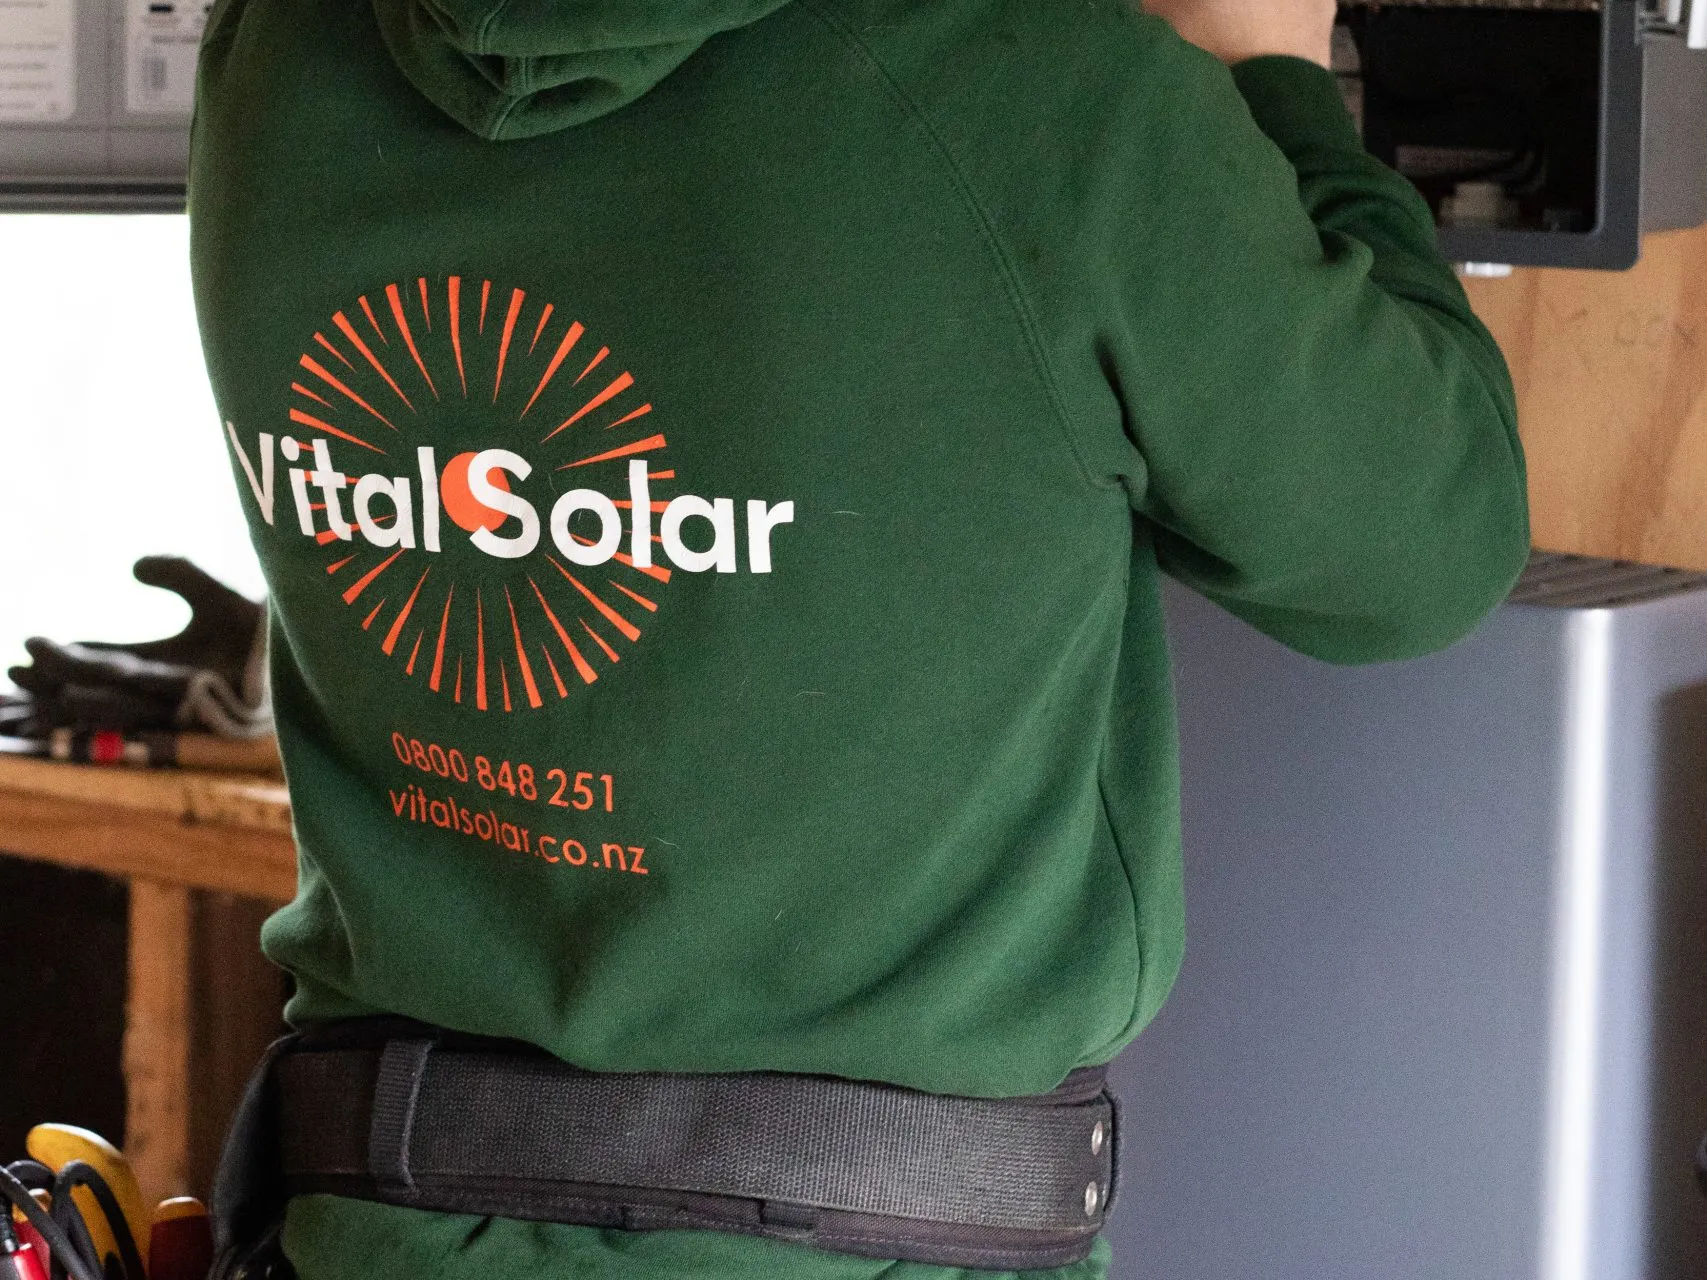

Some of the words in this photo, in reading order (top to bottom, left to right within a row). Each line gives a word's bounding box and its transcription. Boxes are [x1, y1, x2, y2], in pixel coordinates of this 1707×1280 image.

[391, 731, 469, 783] 0800
[474, 755, 538, 801] 848
[546, 768, 614, 813] 251
[388, 784, 649, 875] vitalsolar.co.nz
